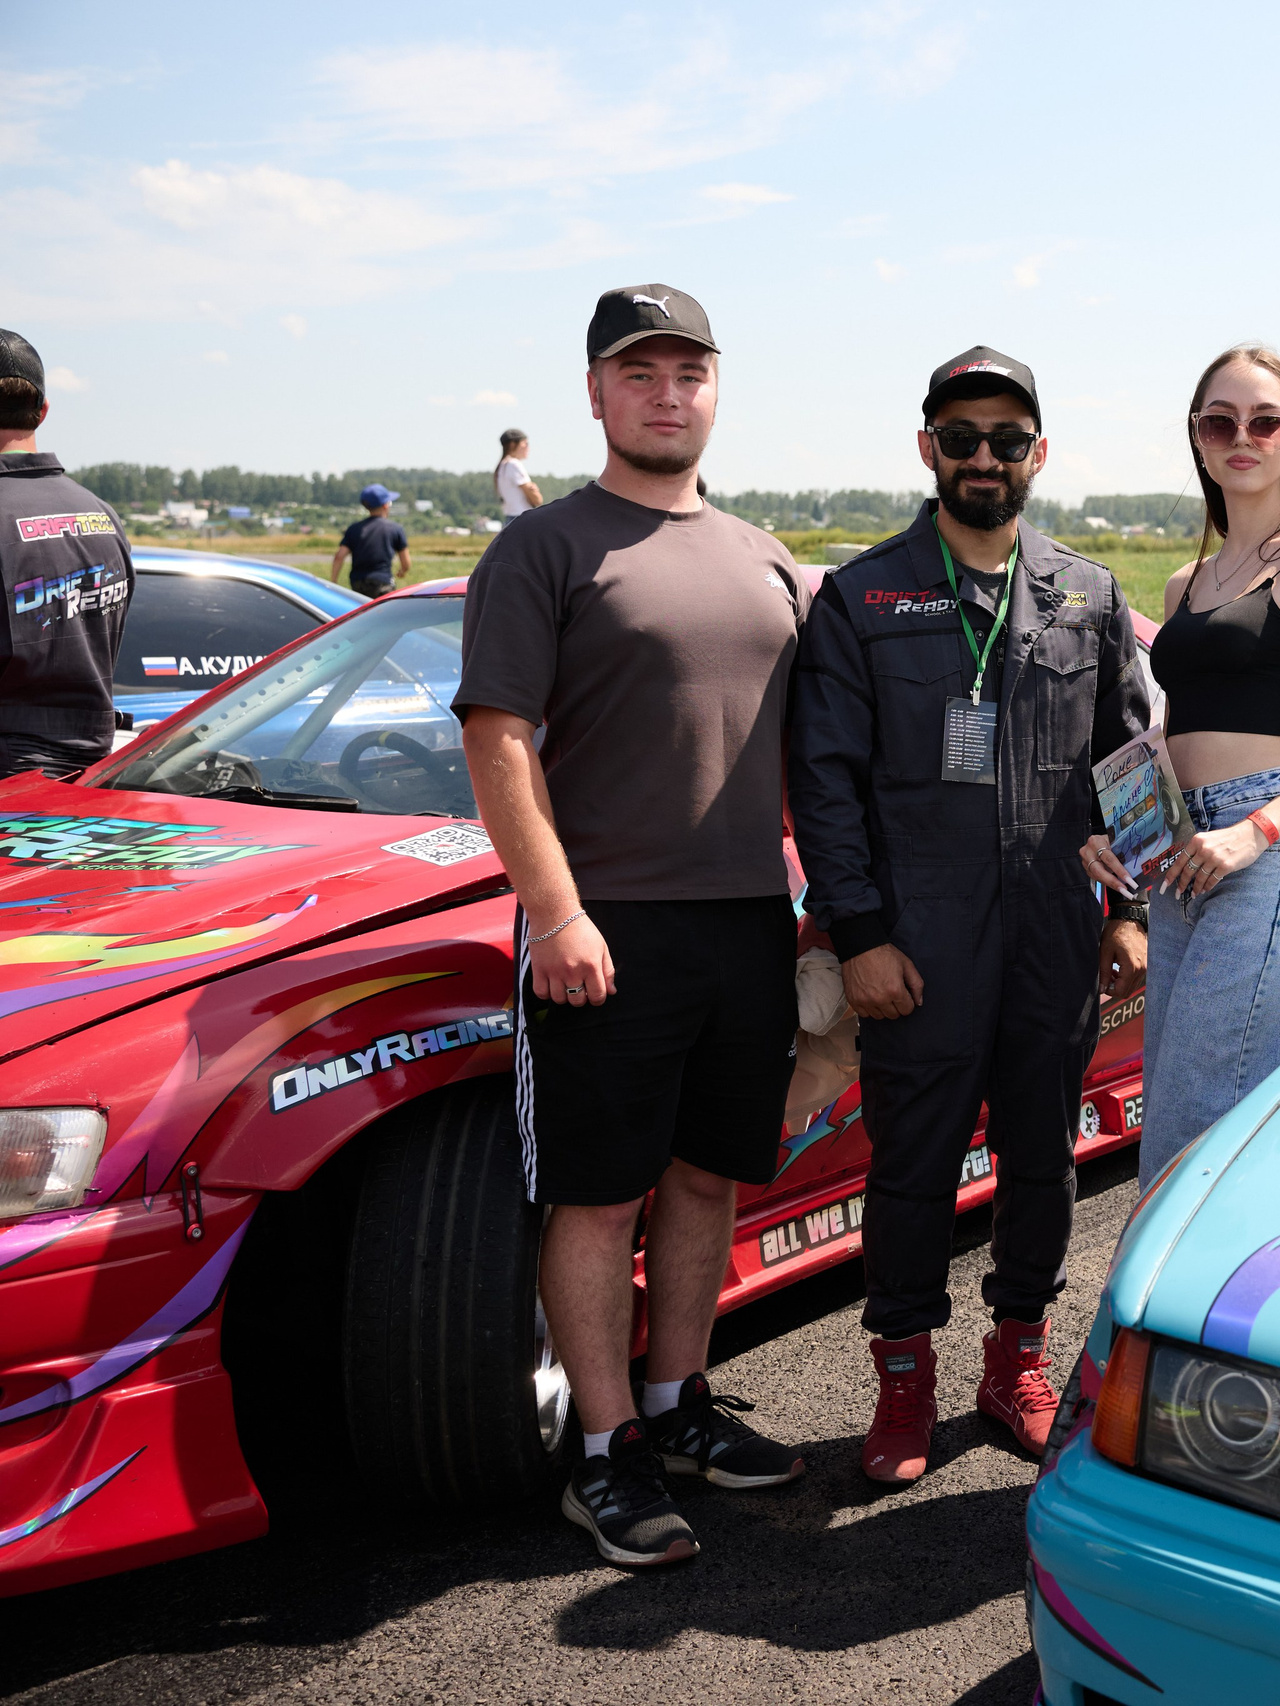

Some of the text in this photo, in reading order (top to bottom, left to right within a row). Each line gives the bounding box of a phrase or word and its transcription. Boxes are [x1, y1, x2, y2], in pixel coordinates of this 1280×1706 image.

[14, 564, 105, 614] DRIFT
[864, 590, 930, 604] DRIFT
[895, 599, 961, 614] READY
[0, 830, 304, 864] READY
[1142, 845, 1176, 875] DRIFT
[1101, 996, 1145, 1034] SCHO
[272, 1013, 514, 1111] ONLYRACING.
